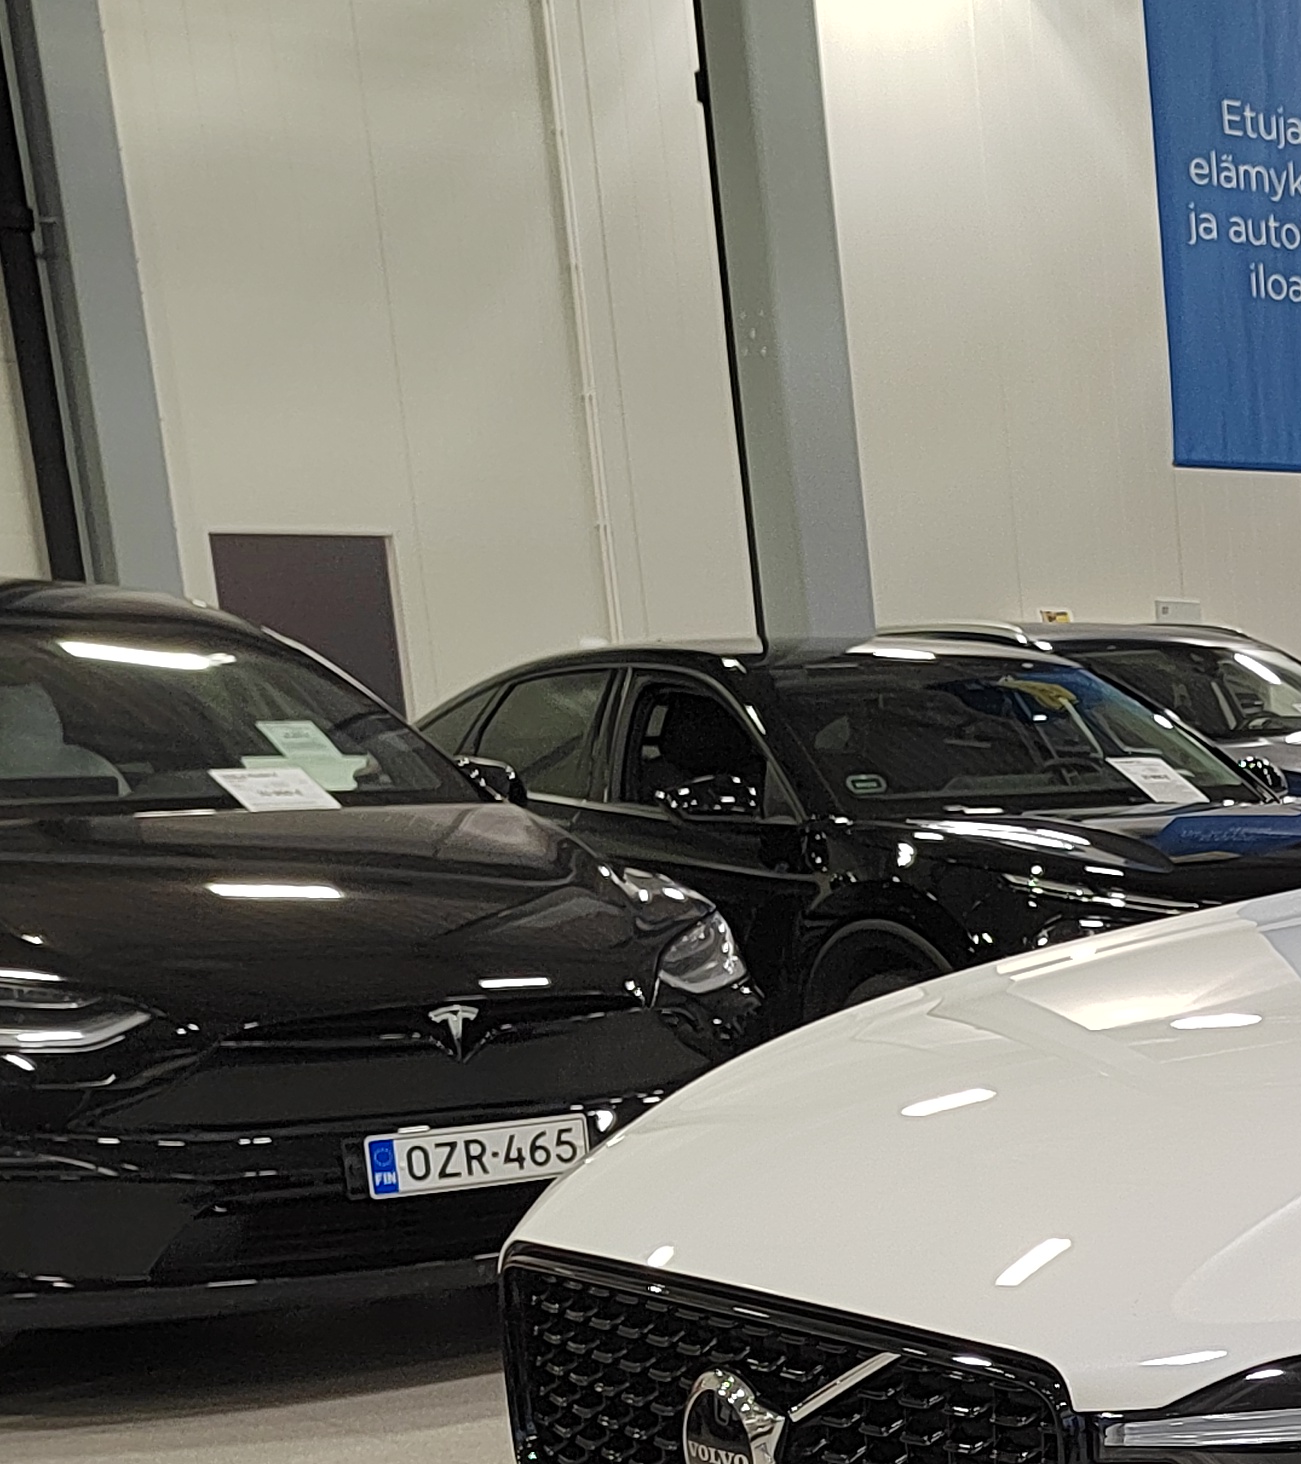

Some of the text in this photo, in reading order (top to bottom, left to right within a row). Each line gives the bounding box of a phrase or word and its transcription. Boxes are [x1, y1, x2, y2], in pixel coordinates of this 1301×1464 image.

[1188, 202, 1217, 246] ja
[406, 1127, 578, 1181] OZR-465
[375, 1171, 397, 1187] FIN
